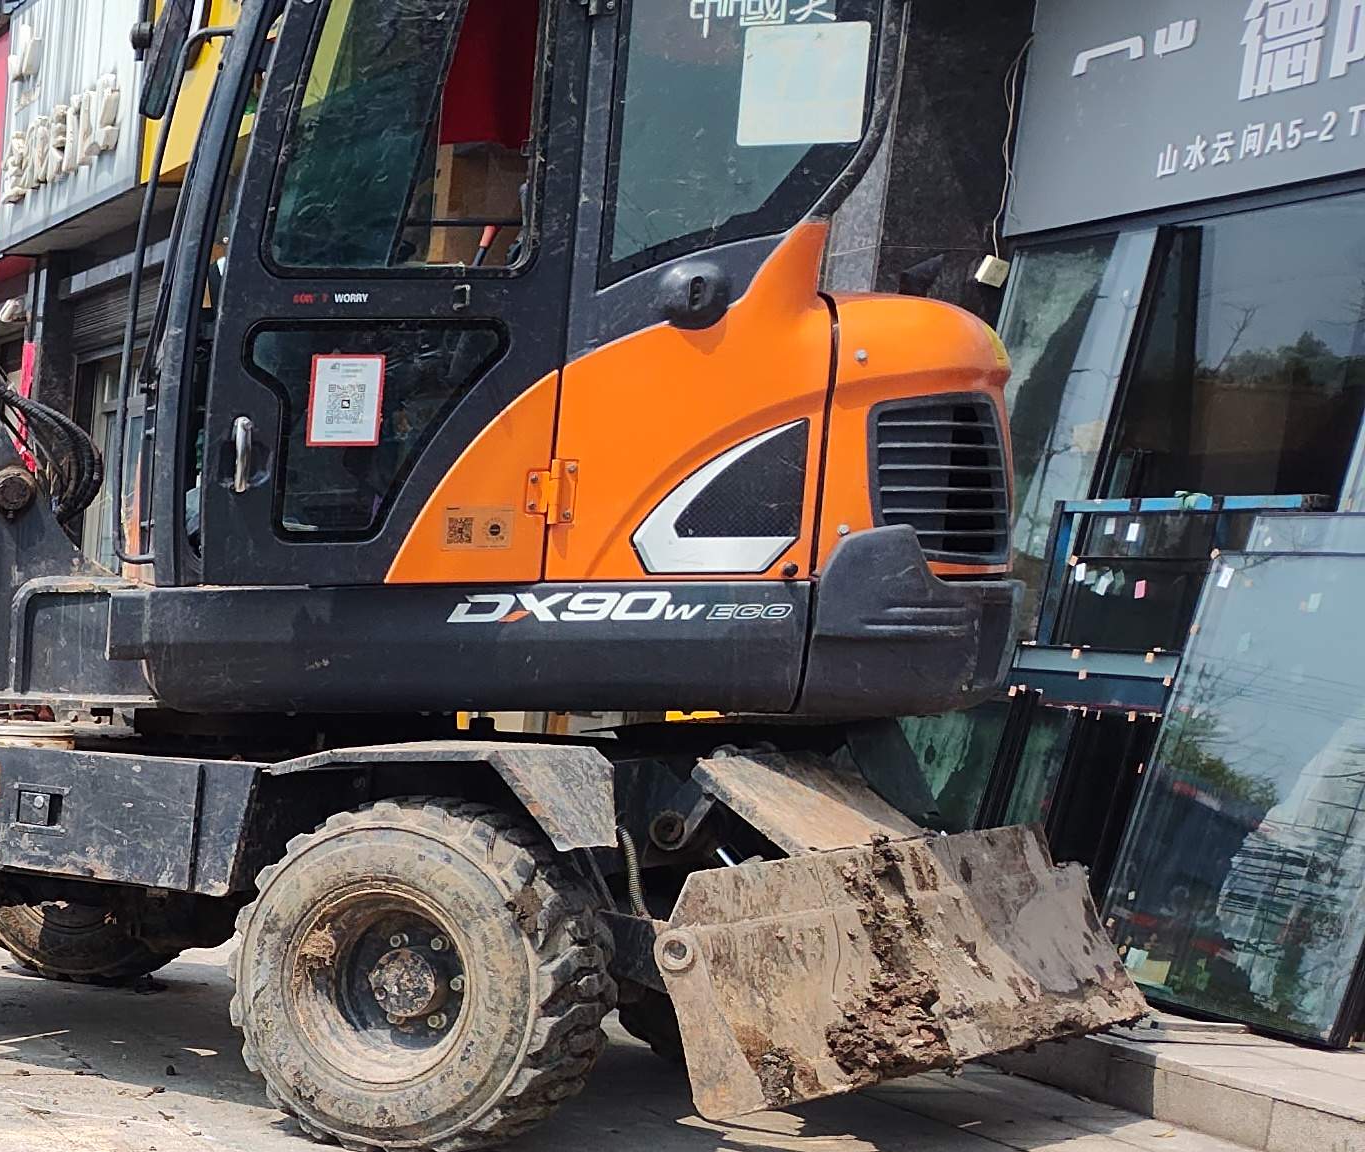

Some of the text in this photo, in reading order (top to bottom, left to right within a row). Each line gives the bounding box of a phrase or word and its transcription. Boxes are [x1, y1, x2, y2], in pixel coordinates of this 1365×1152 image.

[1156, 110, 1338, 179] 山水云间A5-2
[334, 293, 369, 303] WORRY
[706, 603, 794, 621] ECO
